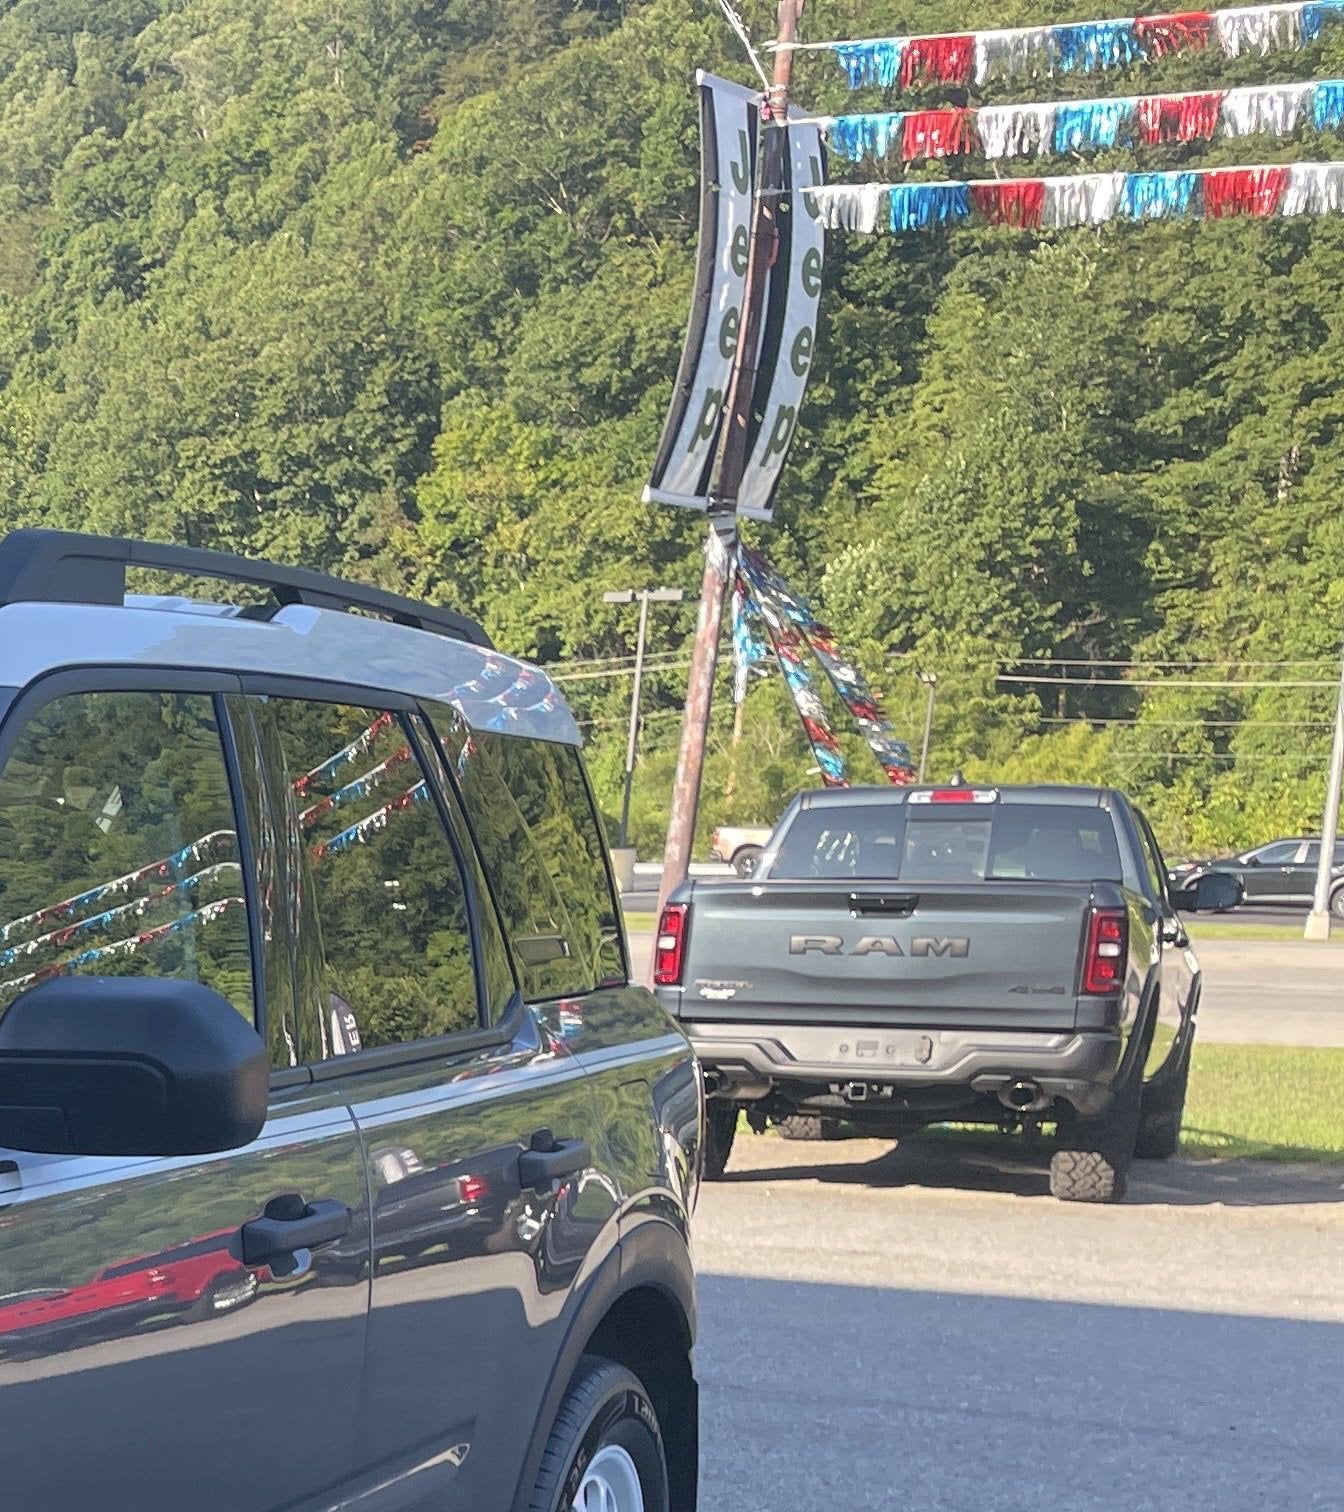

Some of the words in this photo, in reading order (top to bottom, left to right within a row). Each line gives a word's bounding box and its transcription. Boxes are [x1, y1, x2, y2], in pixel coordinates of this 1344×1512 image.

[688, 129, 748, 453] Jeep
[760, 156, 822, 468] Jeep
[789, 935, 971, 958] RAM
